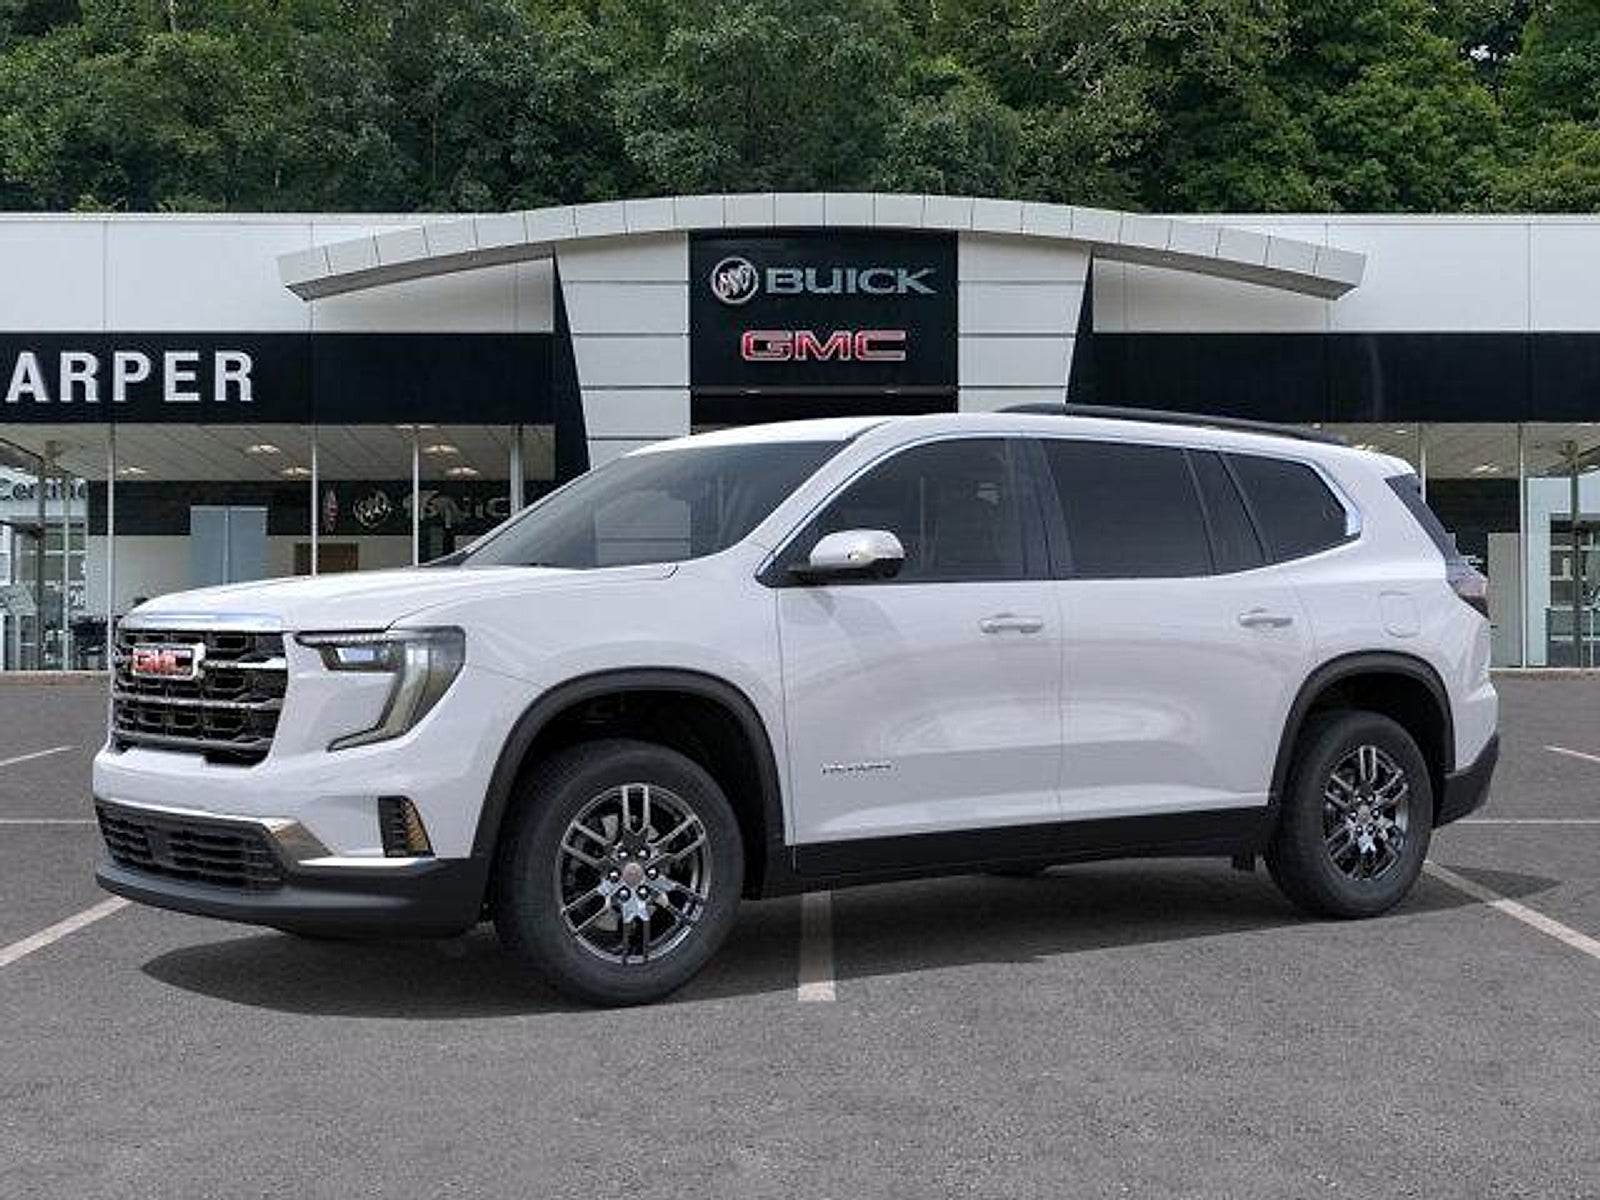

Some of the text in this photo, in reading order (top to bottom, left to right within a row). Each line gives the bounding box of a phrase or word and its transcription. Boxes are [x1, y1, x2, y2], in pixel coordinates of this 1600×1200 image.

[766, 267, 937, 294] BUICK
[741, 330, 906, 361] GMC
[5, 352, 253, 401] ARPER
